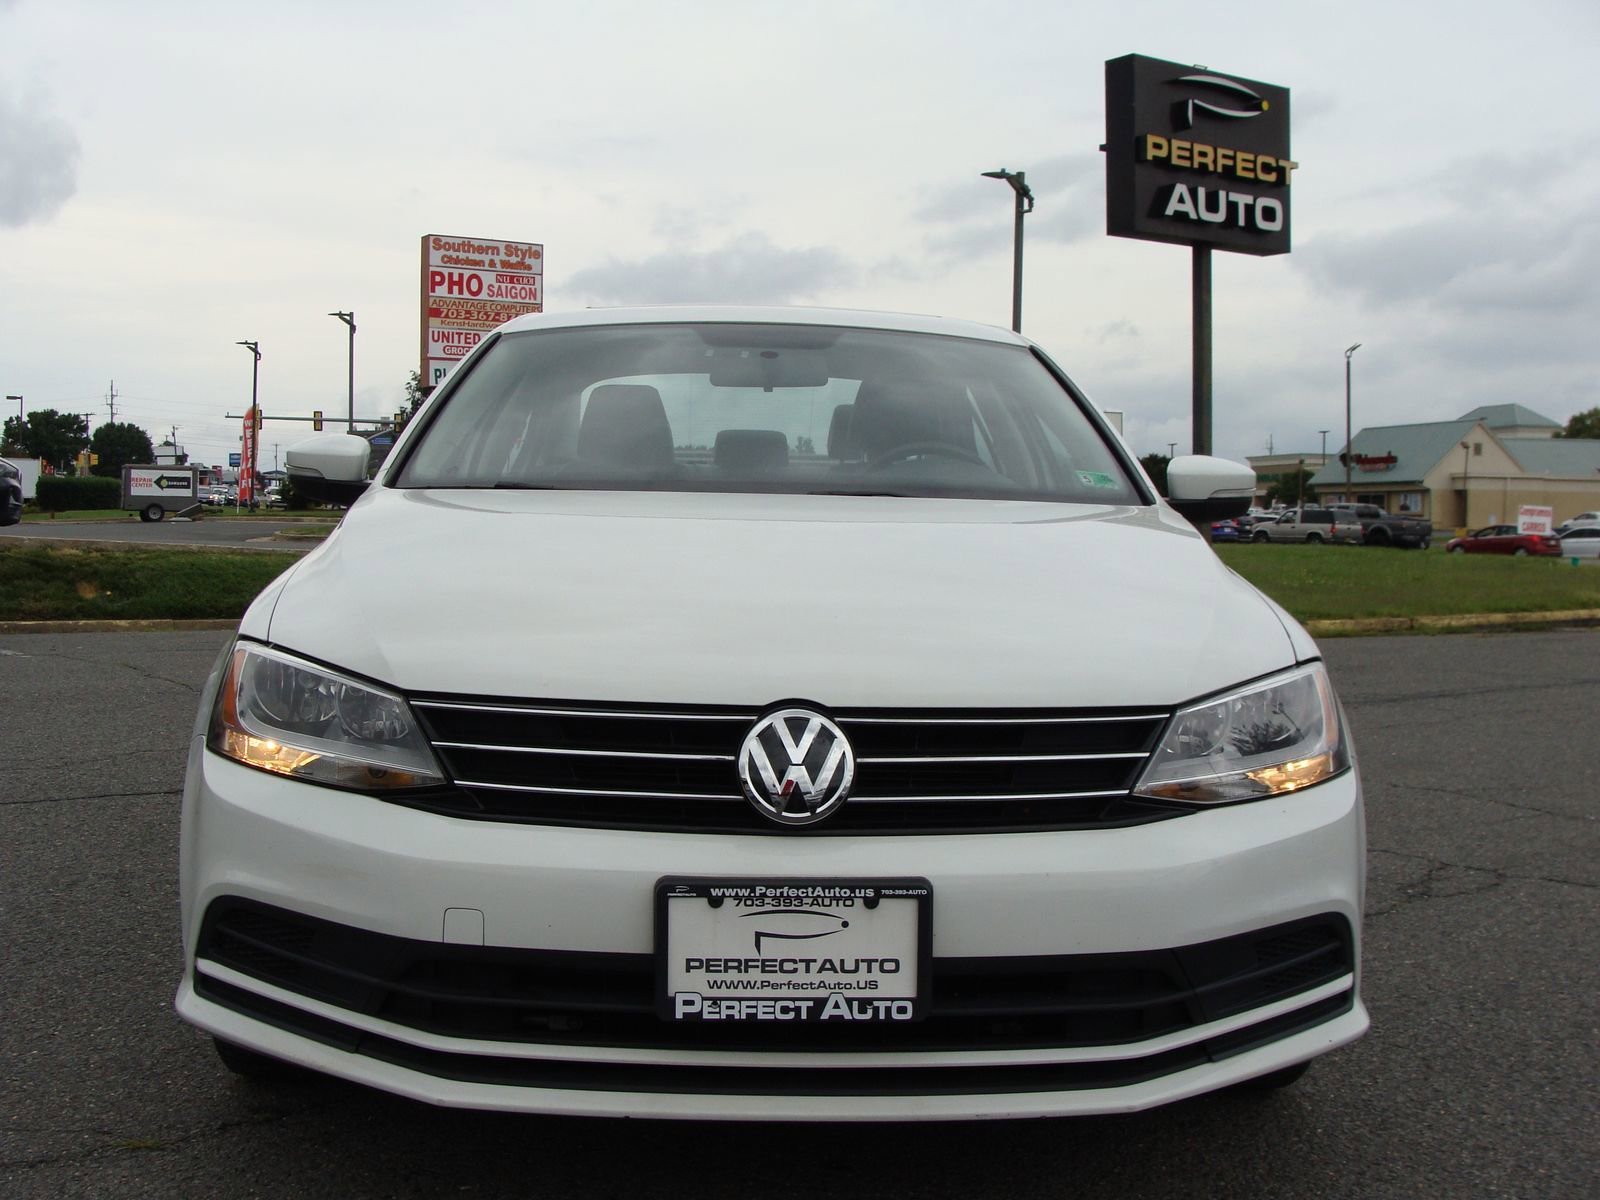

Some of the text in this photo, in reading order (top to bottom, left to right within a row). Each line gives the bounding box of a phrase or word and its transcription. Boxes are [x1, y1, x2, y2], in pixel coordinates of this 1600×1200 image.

[1146, 133, 1299, 185] PERFECT
[1164, 182, 1283, 232] AUTO
[432, 237, 541, 261] Southern Style
[430, 270, 483, 297] PHO
[487, 283, 537, 301] SAIGON
[431, 299, 487, 311] ADVANTAGE
[440, 309, 519, 322] 703-367-87
[440, 319, 501, 329] KensHardwa
[431, 330, 481, 345] UNITED
[710, 886, 875, 898] www.PerfectAuto.us
[733, 897, 855, 908] 703-393-AUTO
[685, 957, 901, 974] PERFECTAUTO
[707, 979, 879, 990] WWW.PerfectAuto.US
